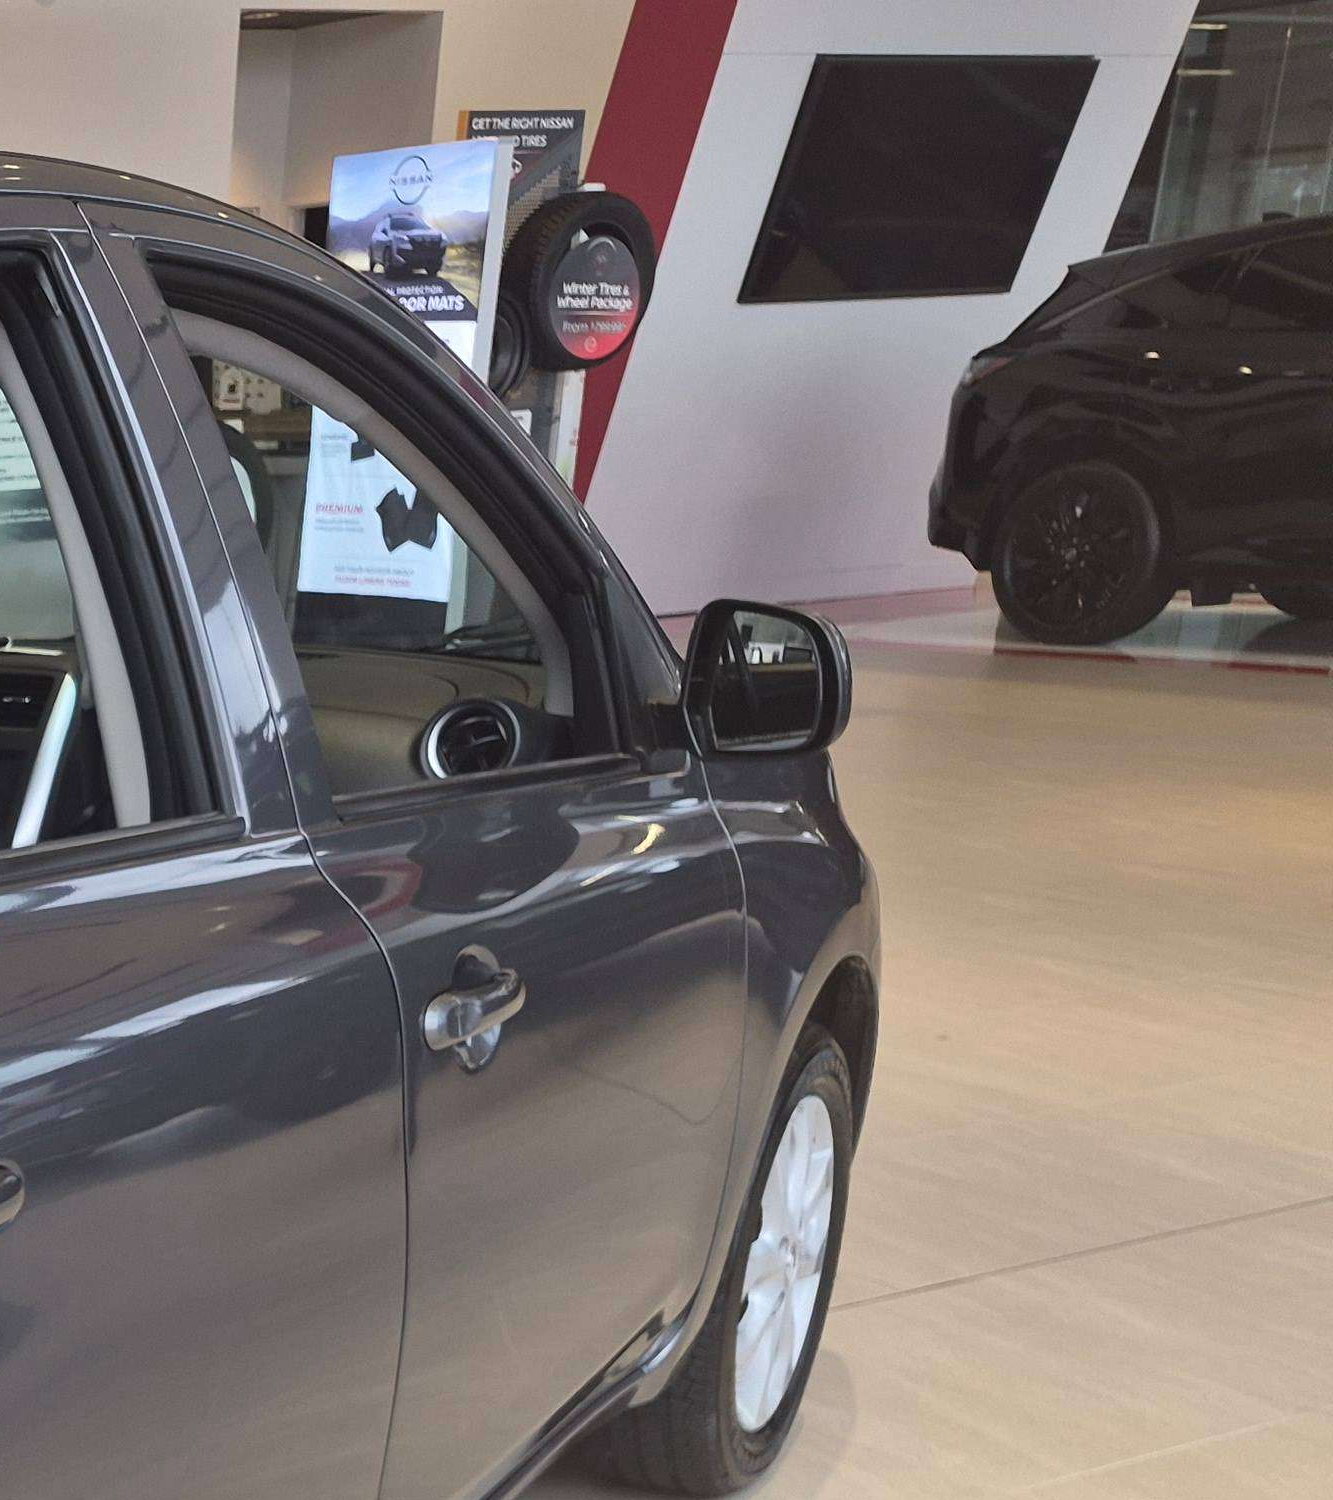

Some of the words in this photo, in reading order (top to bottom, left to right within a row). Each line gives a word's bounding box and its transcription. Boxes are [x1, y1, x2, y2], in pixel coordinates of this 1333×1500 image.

[472, 117, 492, 130] GET
[493, 117, 511, 130] THE
[511, 117, 540, 130] RIGHT
[540, 116, 574, 130] NISSAN
[522, 134, 548, 148] TIRES
[389, 173, 434, 187] NISSAN
[563, 281, 598, 295] Winter
[599, 281, 622, 296] Tires
[428, 294, 465, 312] MATS
[557, 295, 590, 309] Wheel
[591, 296, 633, 313] Package
